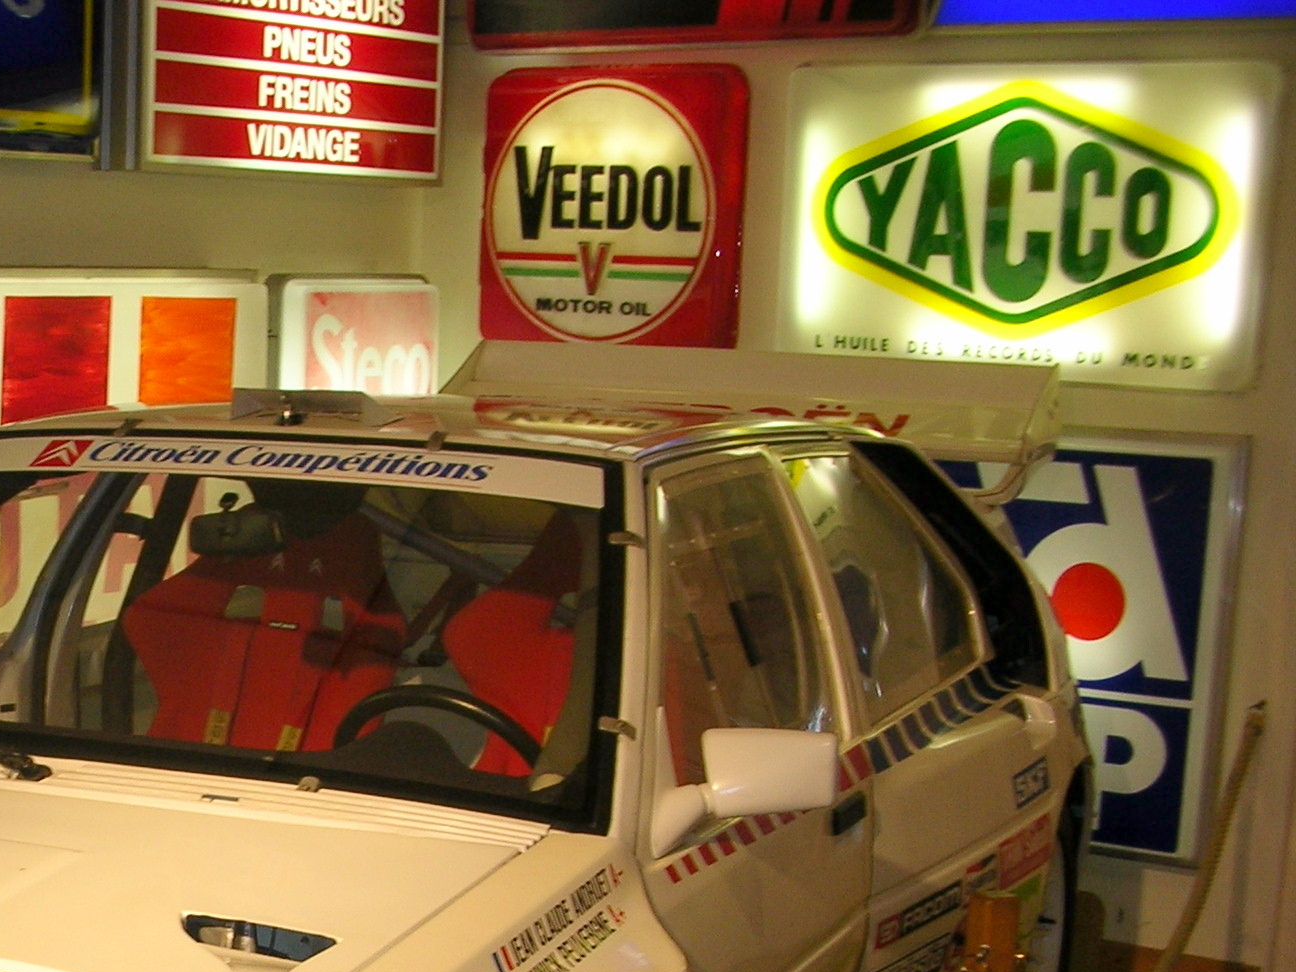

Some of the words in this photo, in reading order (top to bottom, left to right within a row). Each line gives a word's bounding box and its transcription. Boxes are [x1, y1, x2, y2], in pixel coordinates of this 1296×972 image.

[263, 25, 352, 67] PNEUS
[257, 74, 352, 115] FREINS
[246, 122, 361, 163] VIDANGE
[514, 145, 702, 239] VEEDOL
[856, 118, 1172, 303] YACCO
[536, 297, 612, 315] MOTOR
[620, 301, 652, 317] OIL
[907, 339, 944, 357] DES
[1076, 349, 1103, 366] DU
[87, 441, 222, 469] Citroën
[225, 444, 494, 484] Compétitions
[508, 936, 540, 967] JEAN
